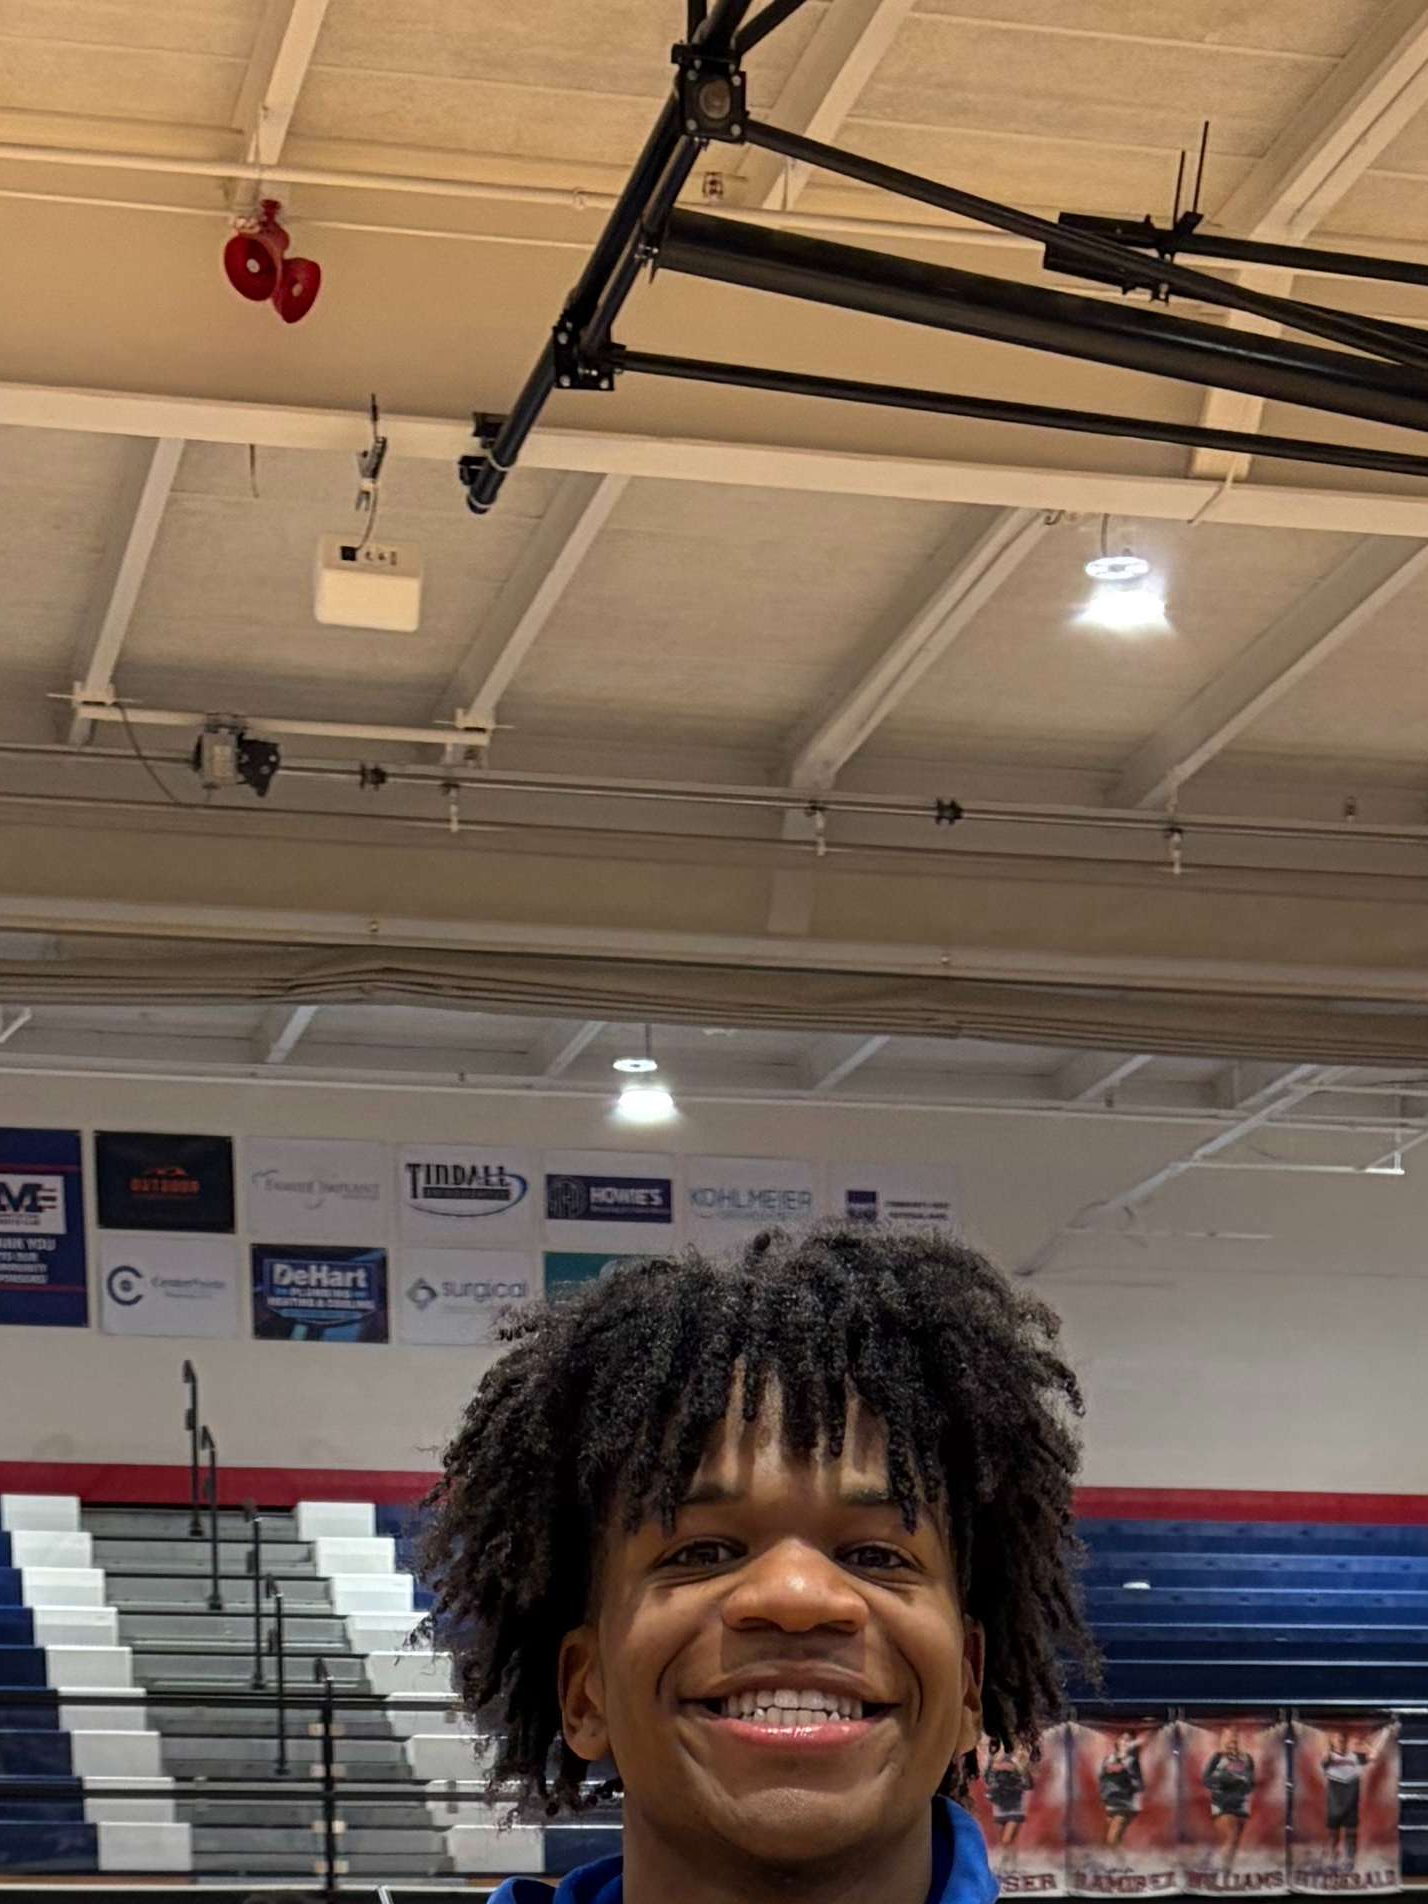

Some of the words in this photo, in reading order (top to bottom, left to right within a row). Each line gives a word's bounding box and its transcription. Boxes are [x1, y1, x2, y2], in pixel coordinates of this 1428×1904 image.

[405, 1162, 511, 1200] TINDALL
[273, 1263, 368, 1288] DeHart
[441, 1279, 526, 1303] surgical
